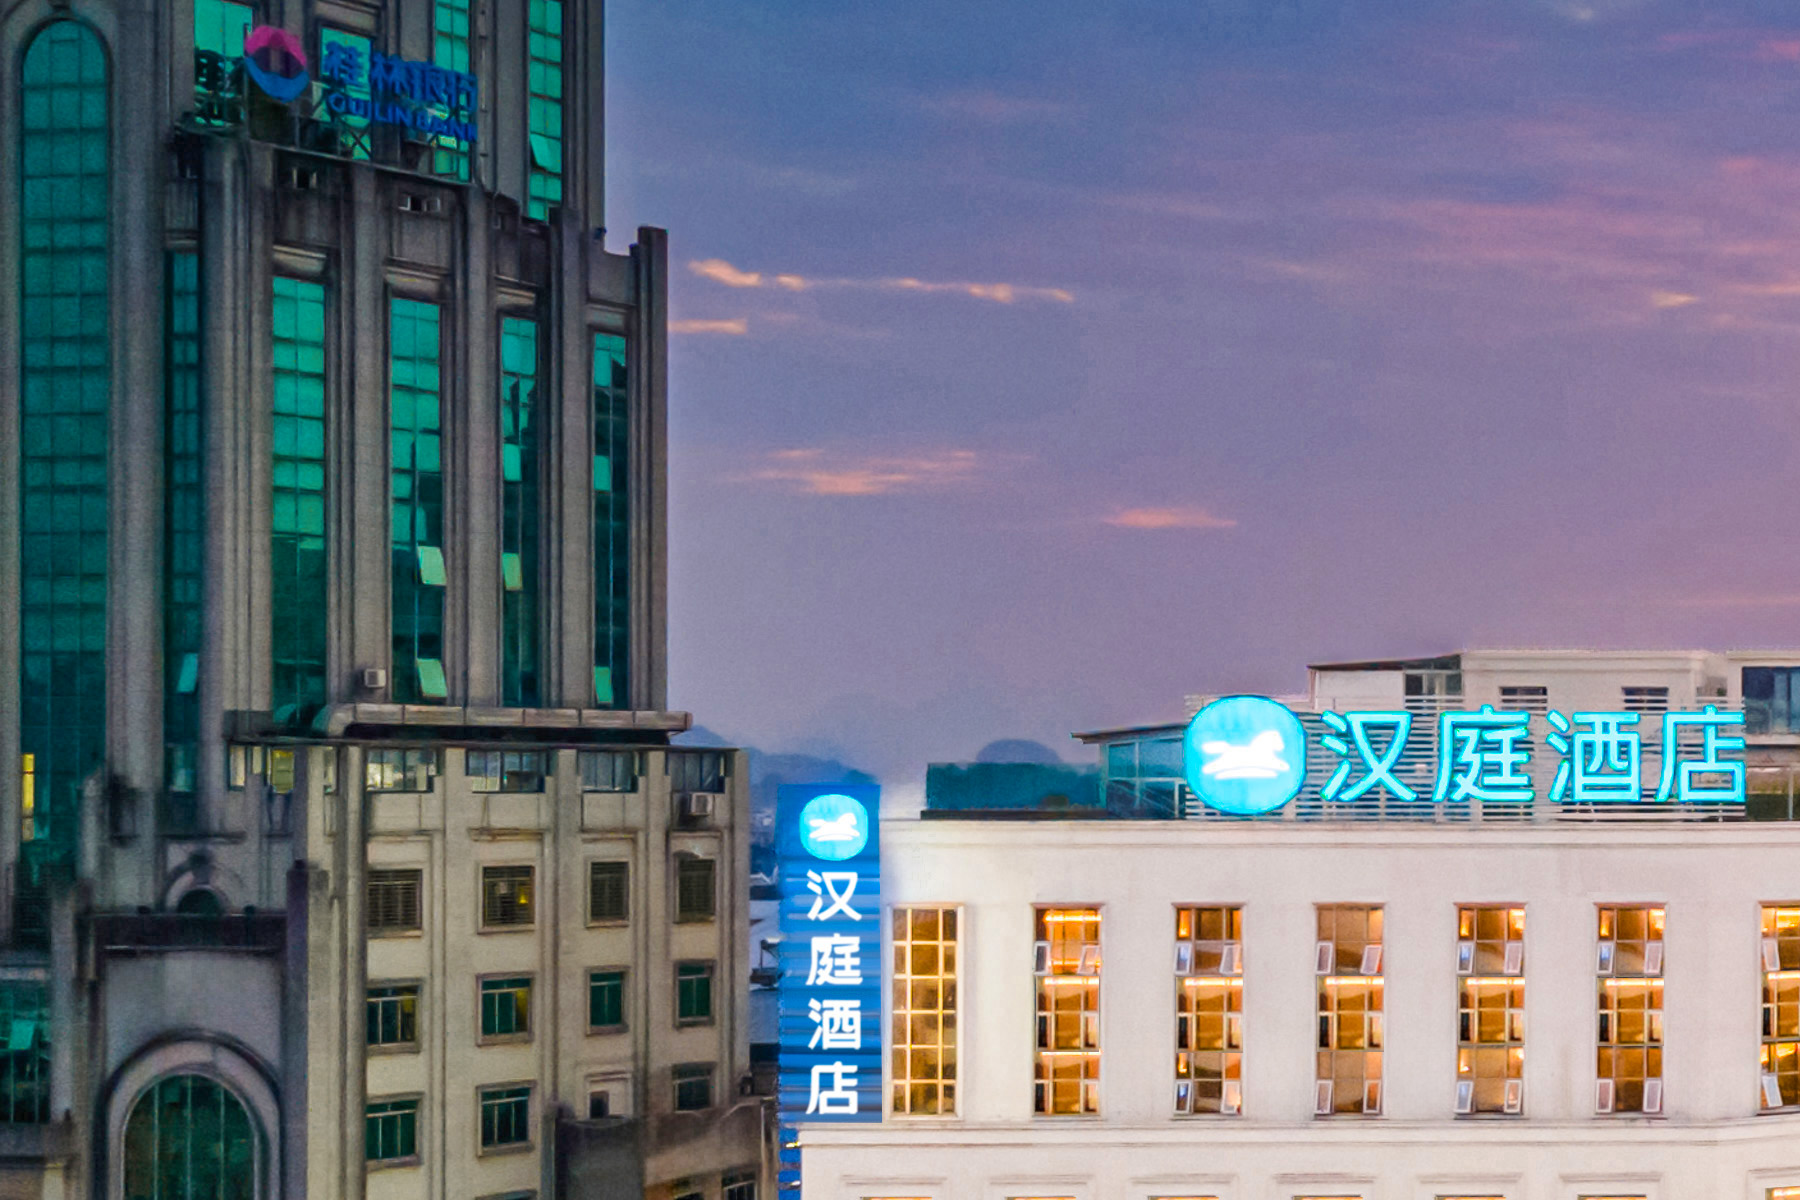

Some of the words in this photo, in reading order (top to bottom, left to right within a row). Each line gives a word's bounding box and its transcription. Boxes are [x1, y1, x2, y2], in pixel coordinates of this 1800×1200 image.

[324, 40, 478, 112] 桂林银行
[328, 92, 413, 128] GUILIN
[1319, 704, 1746, 802] 汉庭酒店
[805, 869, 863, 1115] 汉庭酒店
